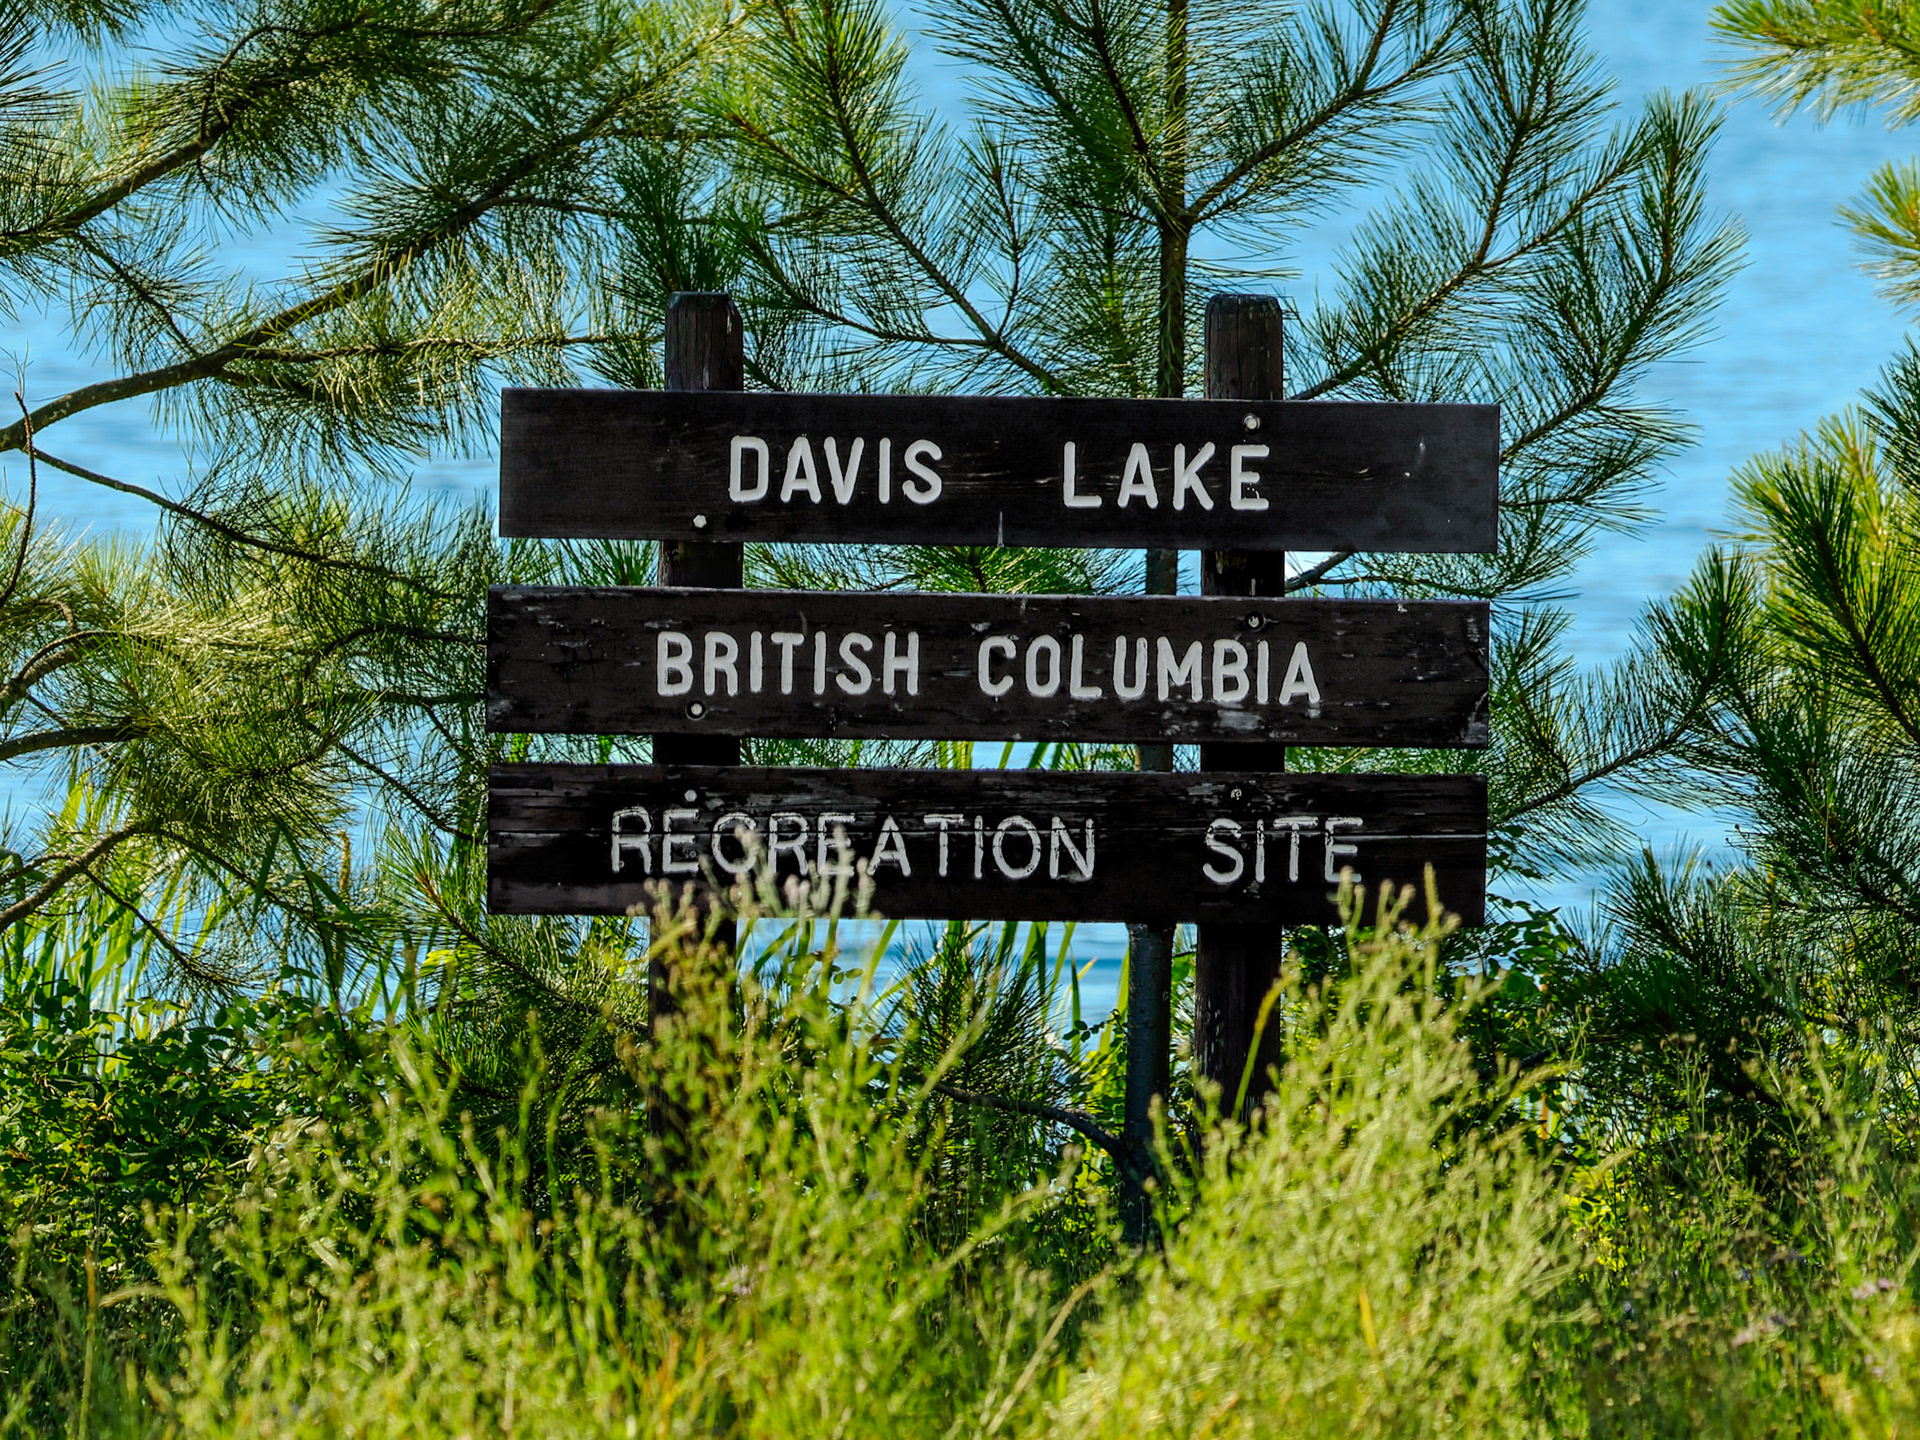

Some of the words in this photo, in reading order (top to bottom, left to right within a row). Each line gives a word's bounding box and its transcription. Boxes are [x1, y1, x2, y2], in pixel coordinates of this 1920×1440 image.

[728, 435, 943, 505] DAVIS
[1063, 441, 1270, 511] LAKE
[657, 631, 919, 697] BRITISH
[978, 634, 1322, 705] COLUMBIA
[611, 806, 1095, 881] RECREATION
[1202, 815, 1363, 884] SITE
